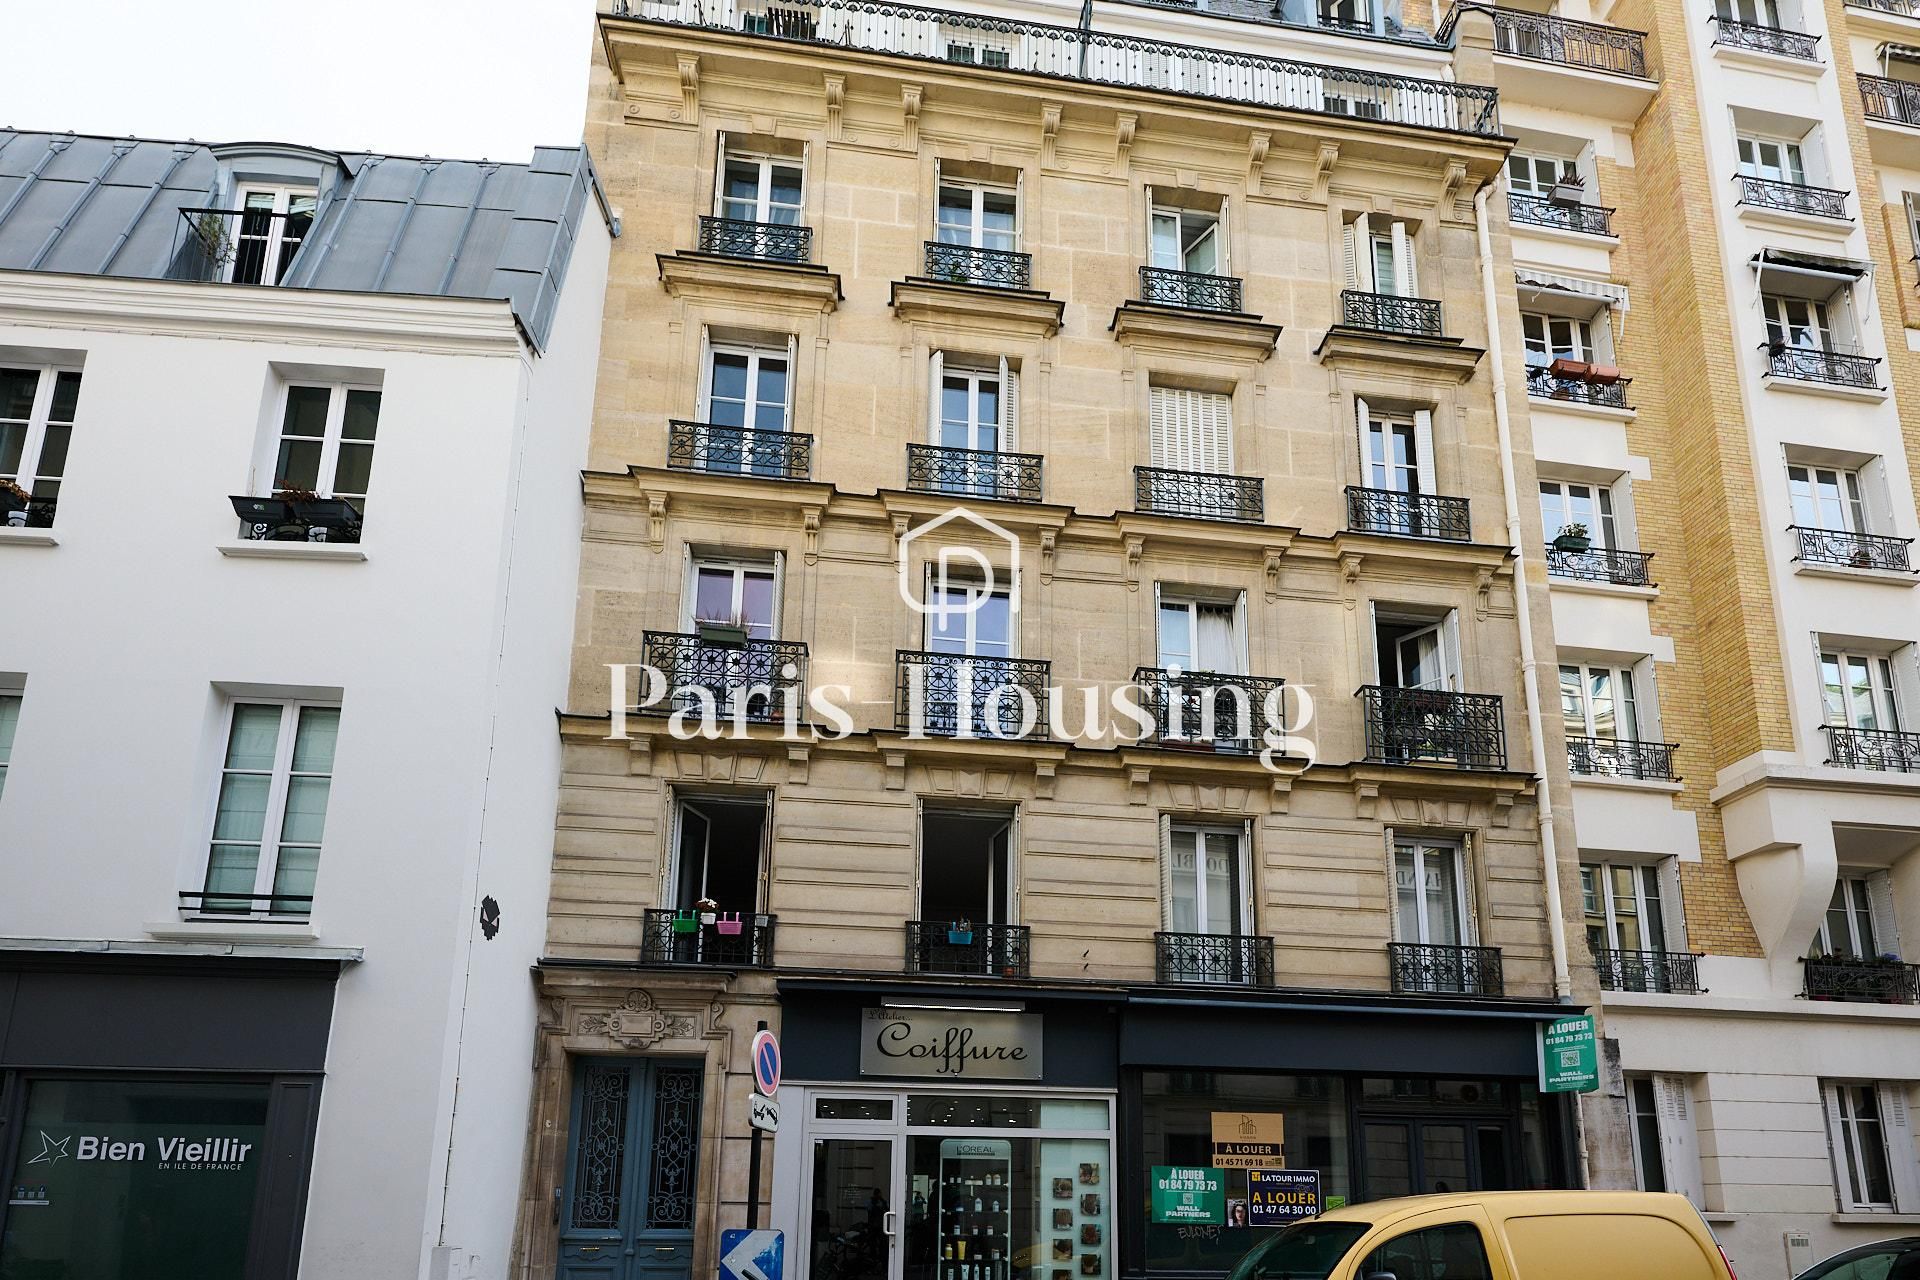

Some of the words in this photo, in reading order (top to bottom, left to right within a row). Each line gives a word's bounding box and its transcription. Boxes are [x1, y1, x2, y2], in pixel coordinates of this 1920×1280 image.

[1557, 1020, 1589, 1033] LOUER
[1555, 1036, 1564, 1044] 84
[1565, 1035, 1573, 1043] 79
[1574, 1033, 1583, 1041] 73
[1584, 1032, 1593, 1040] 73
[877, 1022, 1028, 1073] Coiffure
[1549, 1074, 1594, 1083] PARTNERS
[76, 1136, 146, 1161] Bien
[157, 1136, 252, 1162] Vieillir
[1236, 1145, 1272, 1154] LOUER
[206, 1163, 242, 1171] FRANCE
[1225, 1158, 1234, 1166] 45
[1235, 1158, 1243, 1166] 71
[1244, 1158, 1254, 1166] 69
[1178, 1169, 1205, 1180] LOUER
[1293, 1175, 1316, 1183] IMMO
[1158, 1179, 1170, 1190] 01
[1170, 1179, 1182, 1190] 84
[1183, 1180, 1194, 1190] 79
[1195, 1181, 1206, 1191] 73
[1207, 1181, 1217, 1191] 73
[1252, 1191, 1262, 1203] A
[1267, 1192, 1316, 1204] LOUER
[1165, 1210, 1211, 1218] PARTNERS
[1252, 1204, 1264, 1214] 01
[1266, 1205, 1277, 1214] 47
[1279, 1205, 1290, 1214] 64
[1292, 1206, 1303, 1215] 30
[1305, 1206, 1317, 1215] 00
